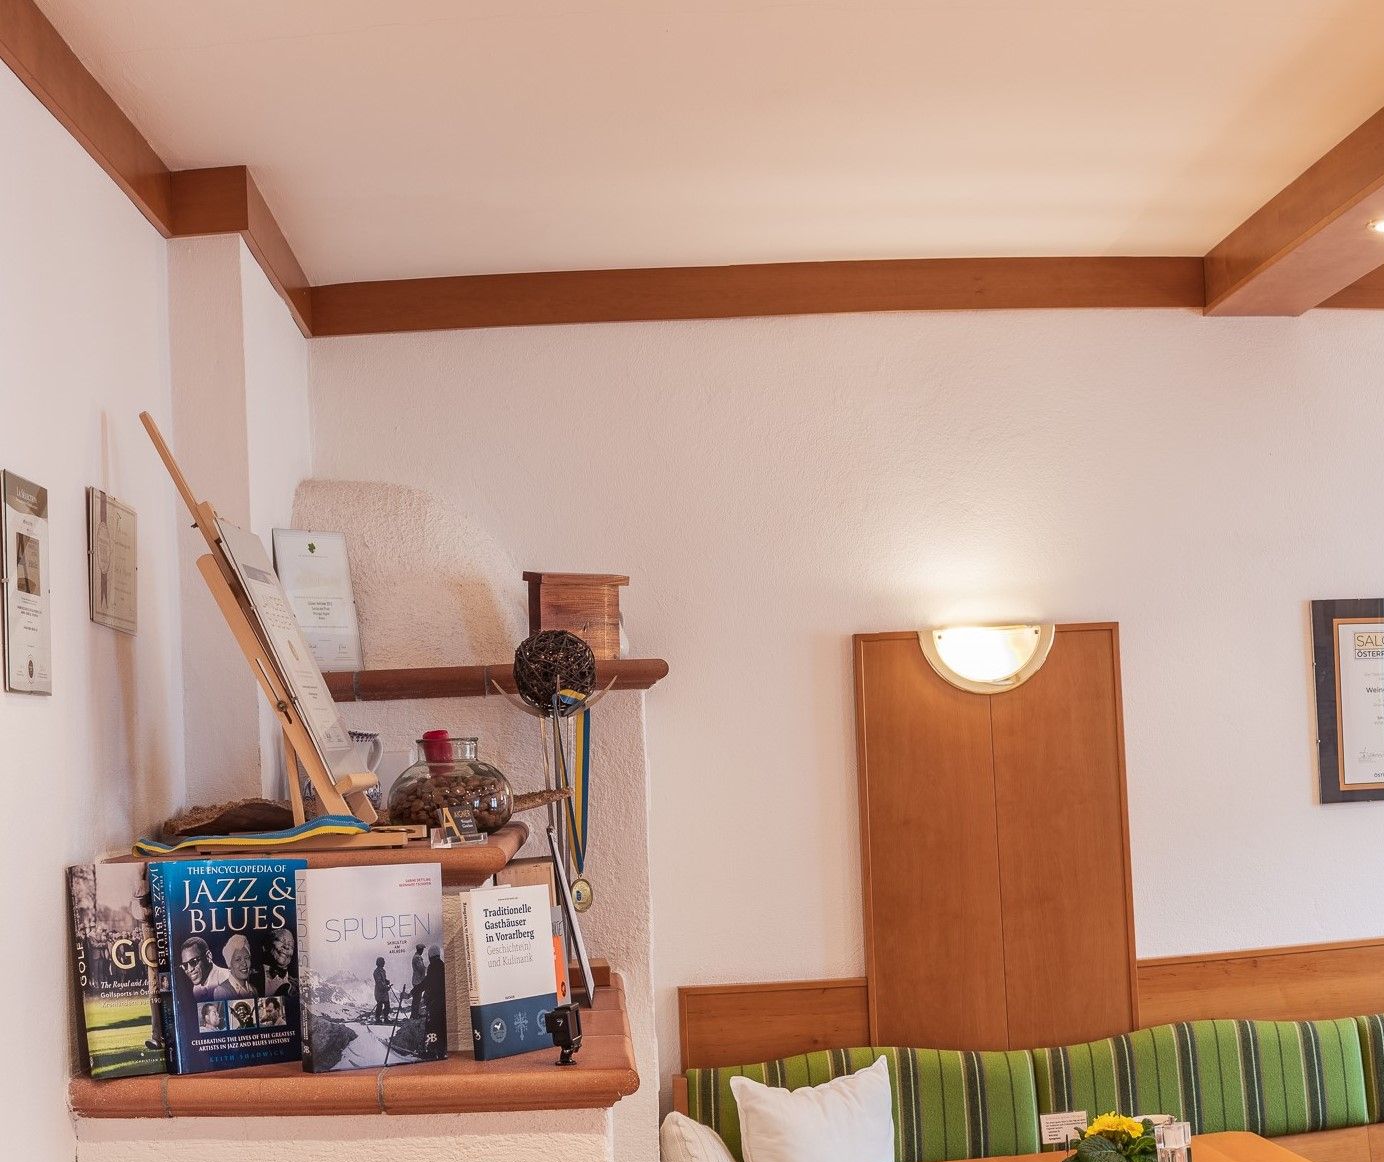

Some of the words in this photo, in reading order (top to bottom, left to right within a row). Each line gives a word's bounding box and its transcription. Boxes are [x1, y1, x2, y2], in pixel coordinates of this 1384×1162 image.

[187, 866, 206, 875] THE
[206, 864, 273, 875] ENCYCLOPEDIA
[275, 864, 287, 873] OF
[149, 868, 161, 902] JAZZ
[182, 877, 258, 912] JAZZ
[268, 876, 296, 901] &
[154, 906, 162, 918] &
[483, 903, 532, 918] Traditionelle
[189, 904, 287, 934] BLUES
[484, 917, 527, 930] Gasthäuser
[325, 912, 431, 943] SPUREN
[155, 920, 167, 965] BLUES
[485, 933, 494, 942] in
[495, 929, 535, 942] Vorarlberg
[486, 941, 532, 956] Geschichte(n)
[77, 942, 88, 987] GOLF
[487, 957, 501, 968] und
[502, 952, 534, 967] Kulinarik
[100, 981, 111, 989] The
[112, 980, 130, 990] Royal
[130, 979, 142, 987] and
[100, 991, 132, 999] Golfsports
[191, 1037, 227, 1046] CELEBRATING
[238, 1034, 252, 1042] LIVES
[271, 1030, 296, 1038] GREATEST
[198, 1043, 220, 1052] ARTISTS
[227, 1042, 239, 1050] JAZZ
[252, 1039, 268, 1047] BLUES
[268, 1037, 290, 1045] HISTORY
